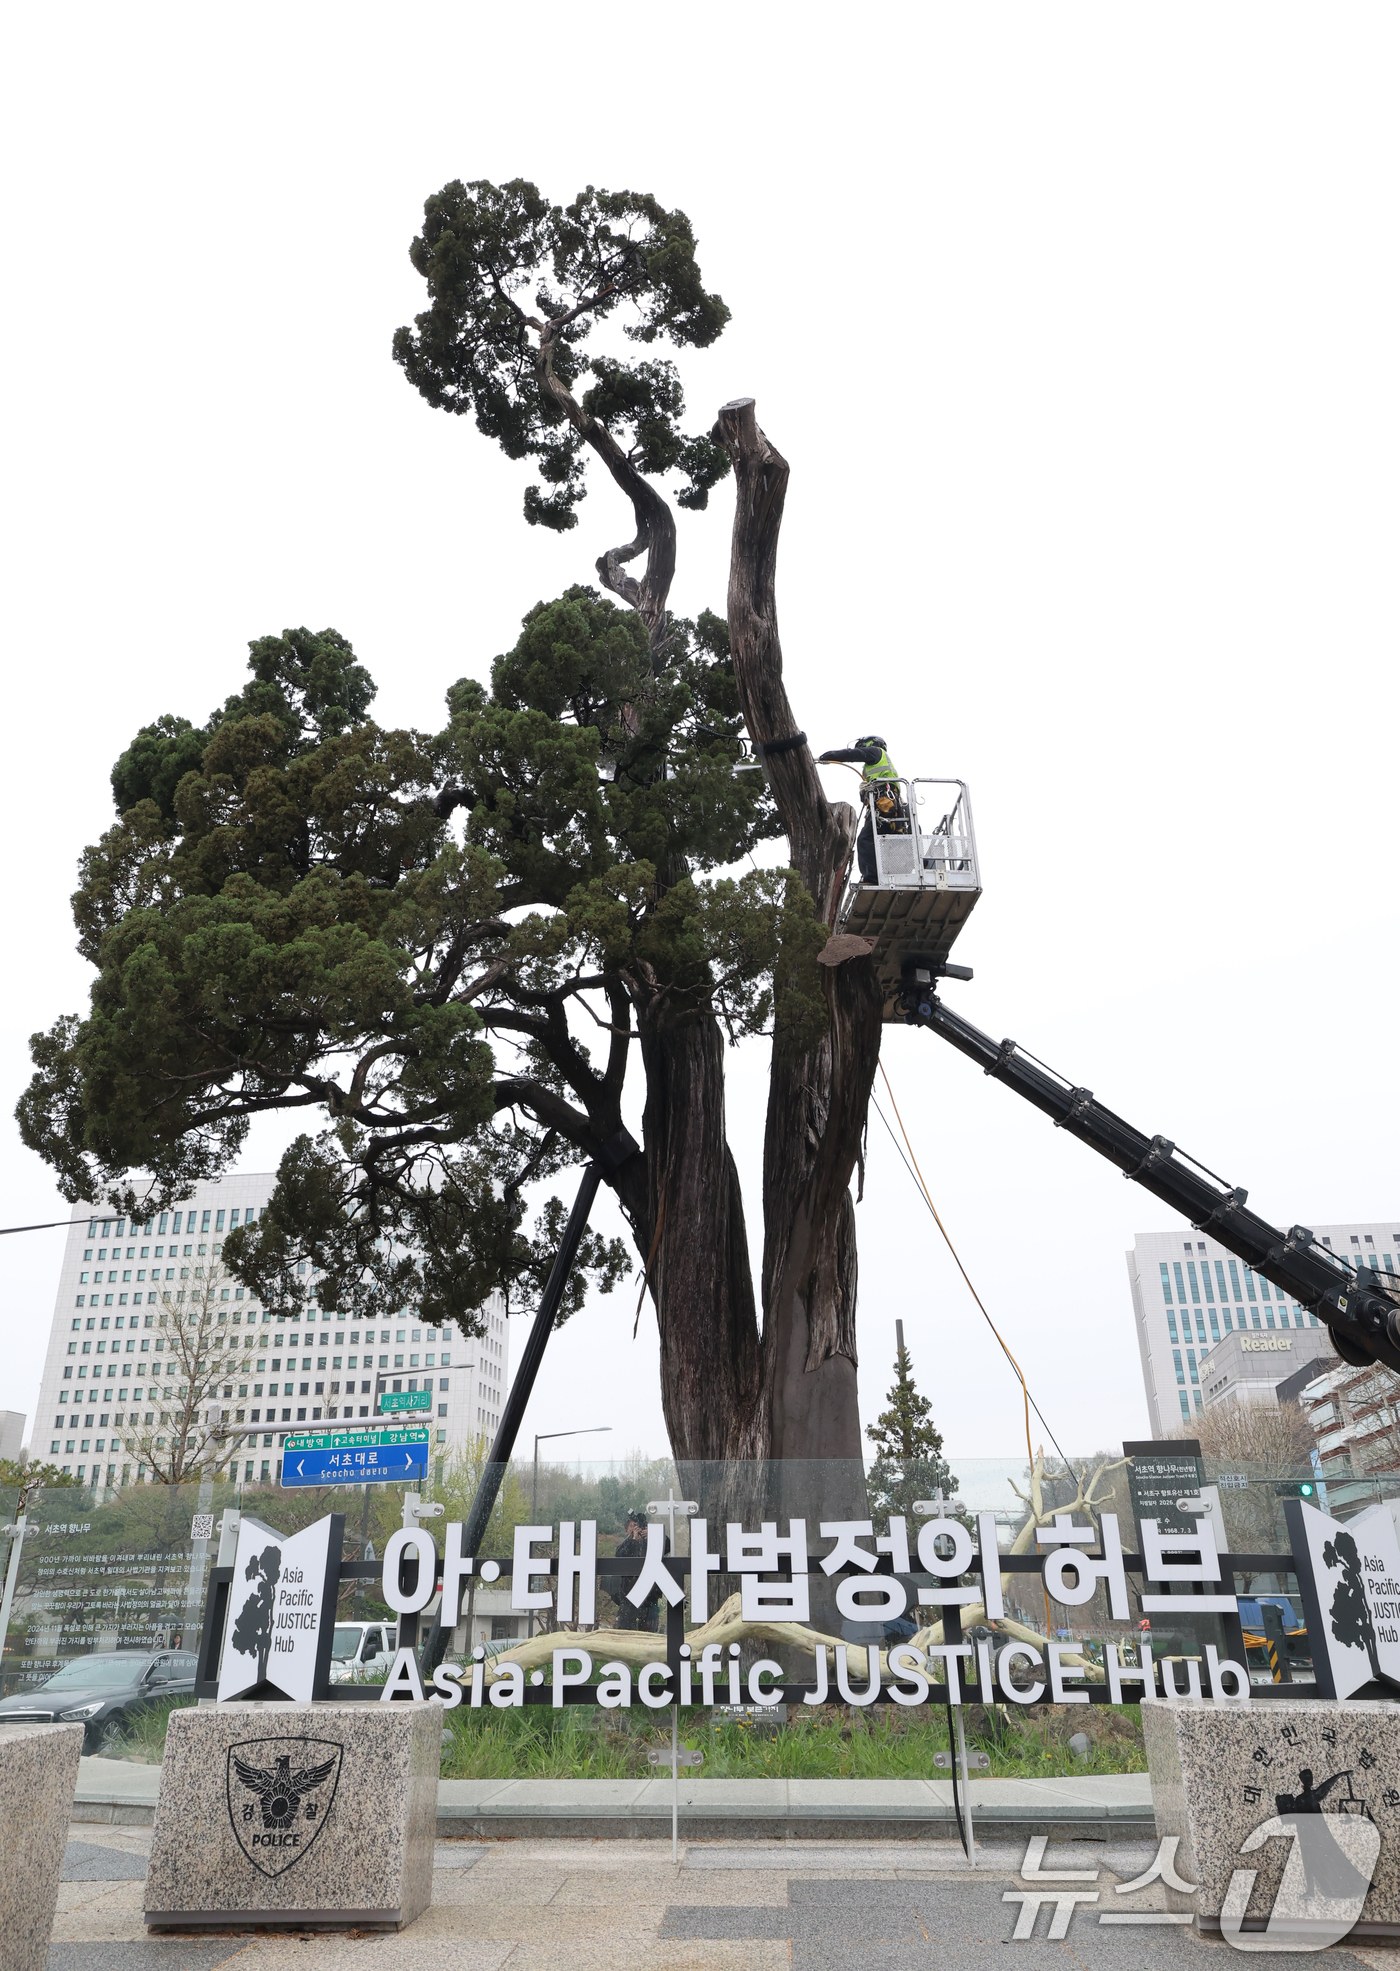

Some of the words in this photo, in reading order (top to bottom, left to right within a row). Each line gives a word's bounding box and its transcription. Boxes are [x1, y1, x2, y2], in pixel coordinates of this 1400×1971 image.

[1240, 1335, 1292, 1352] Reader
[383, 1394, 428, 1408] 서초역사거리
[297, 1438, 324, 1448] 내방역
[341, 1434, 376, 1444] 고속터미널
[390, 1432, 418, 1442] 강남역
[329, 1452, 378, 1466] 서초대로
[1134, 1466, 1155, 1474] 서초역
[44, 1524, 67, 1534] 서초역
[69, 1524, 91, 1533] 향나무
[381, 1519, 597, 1627] 아·태
[626, 1513, 1005, 1623] 사법정의
[1034, 1513, 1239, 1621] 허브
[1364, 1556, 1385, 1572] Asia
[282, 1567, 303, 1583] Asia
[279, 1590, 313, 1606] Pacific
[276, 1613, 317, 1629] JUSTICE
[1377, 1625, 1398, 1643] Hub
[274, 1636, 294, 1652] Hub
[803, 1641, 1090, 1706] JUSTICE
[1101, 1643, 1251, 1704] Hub
[242, 1804, 254, 1821] 경
[305, 1803, 318, 1820] 찰
[252, 1834, 300, 1847] POLICE
